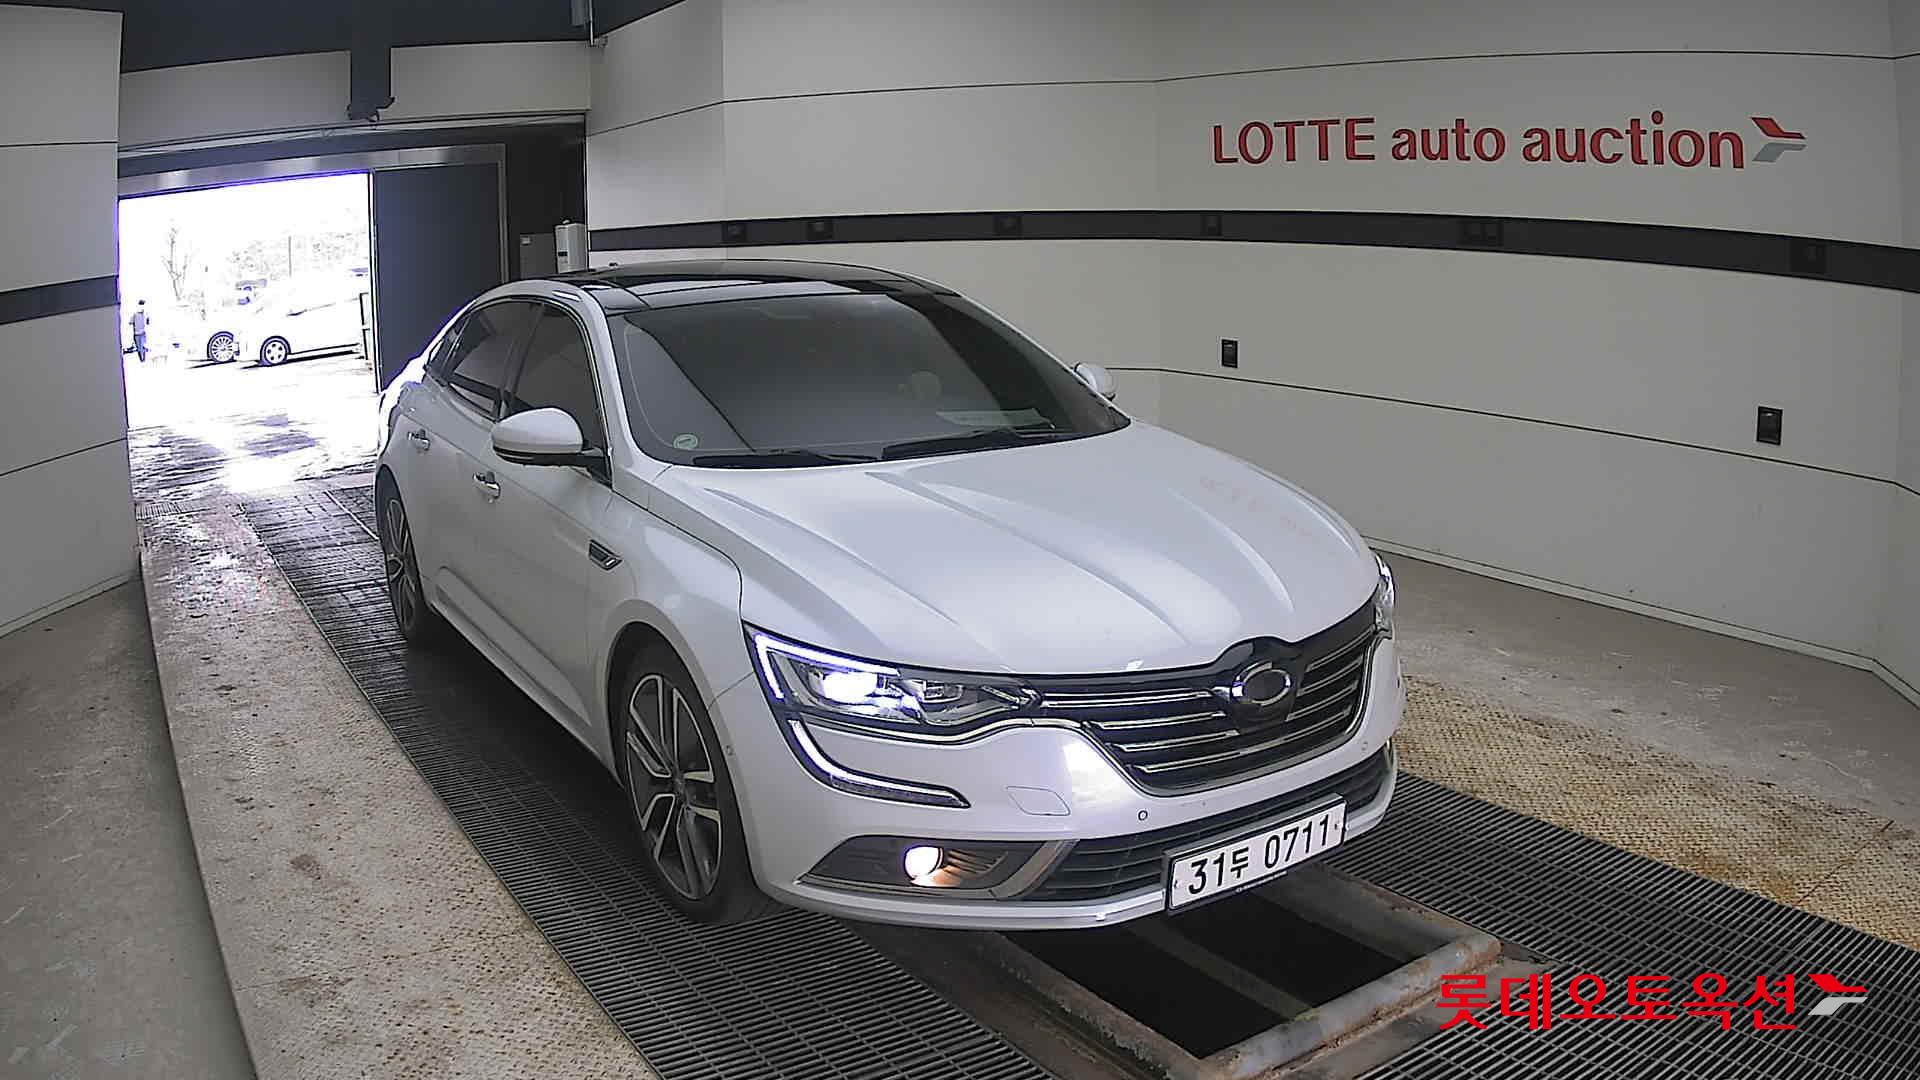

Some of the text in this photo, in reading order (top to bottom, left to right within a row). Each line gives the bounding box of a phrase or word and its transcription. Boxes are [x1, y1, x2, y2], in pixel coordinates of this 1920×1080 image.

[1213, 110, 1744, 169] LOTTE auto auction
[1188, 846, 1249, 895] 31두
[1264, 813, 1329, 869] 0711
